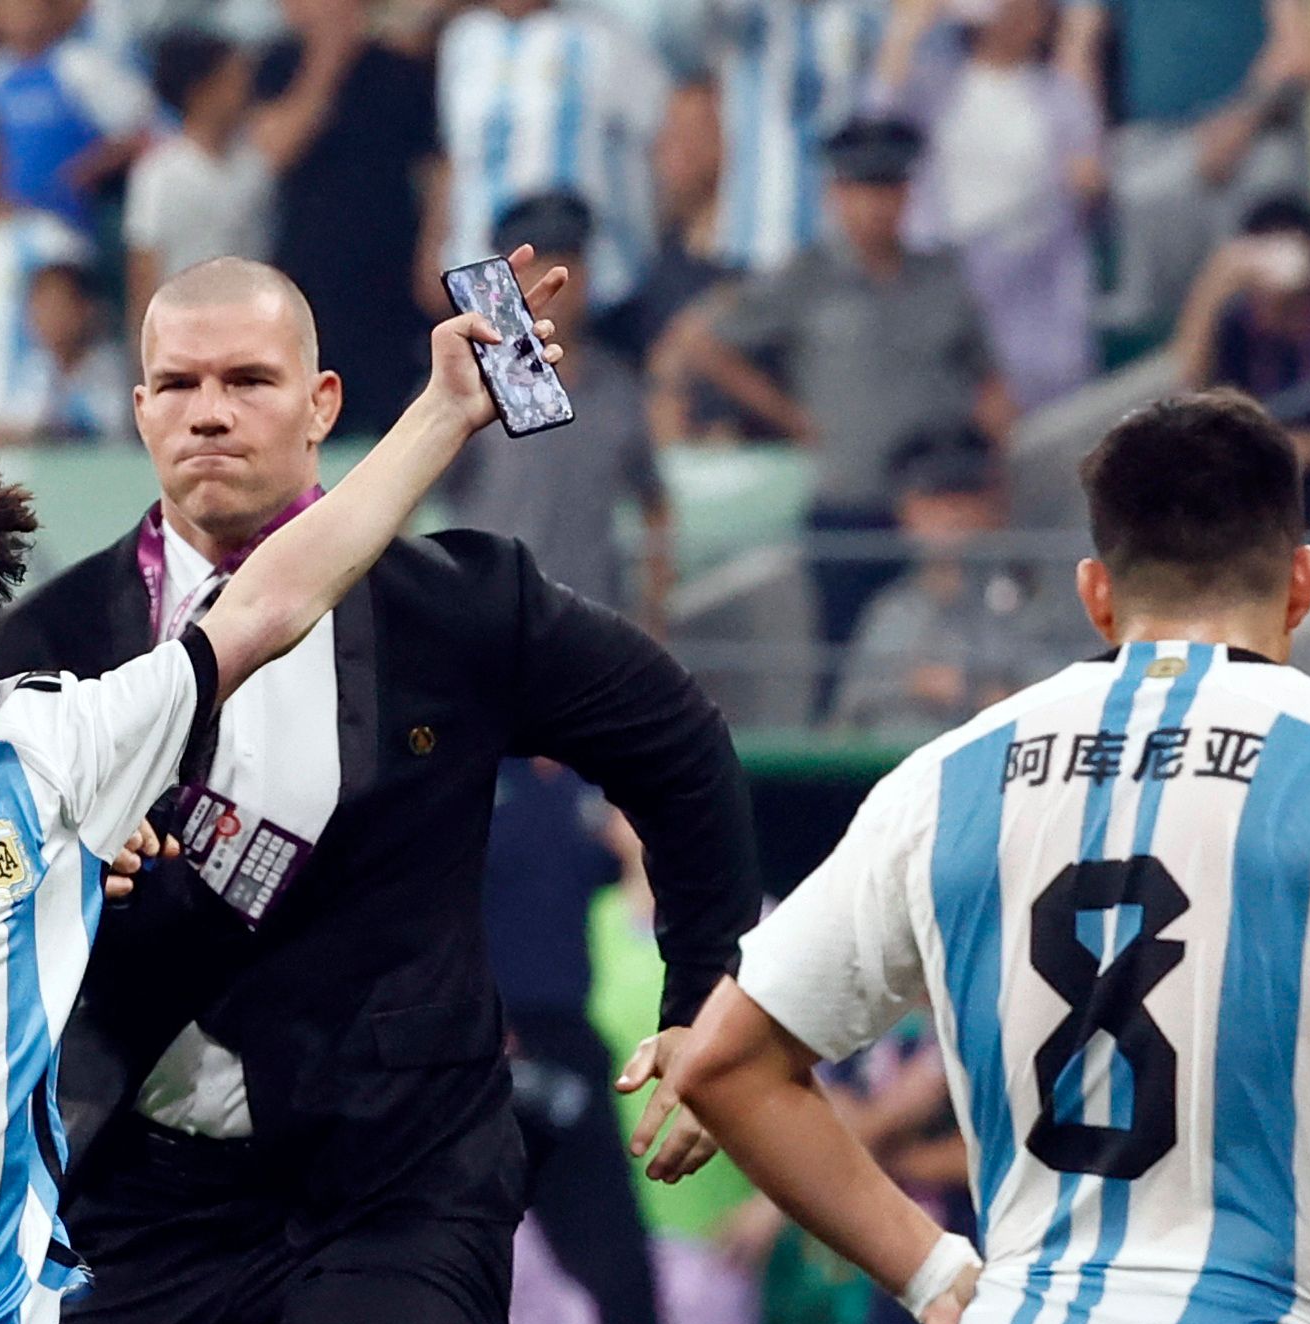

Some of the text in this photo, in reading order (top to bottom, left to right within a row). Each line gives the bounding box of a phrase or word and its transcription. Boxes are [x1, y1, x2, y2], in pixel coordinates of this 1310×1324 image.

[999, 725, 1267, 795] 阿库尼亚
[1024, 854, 1191, 1182] 8
